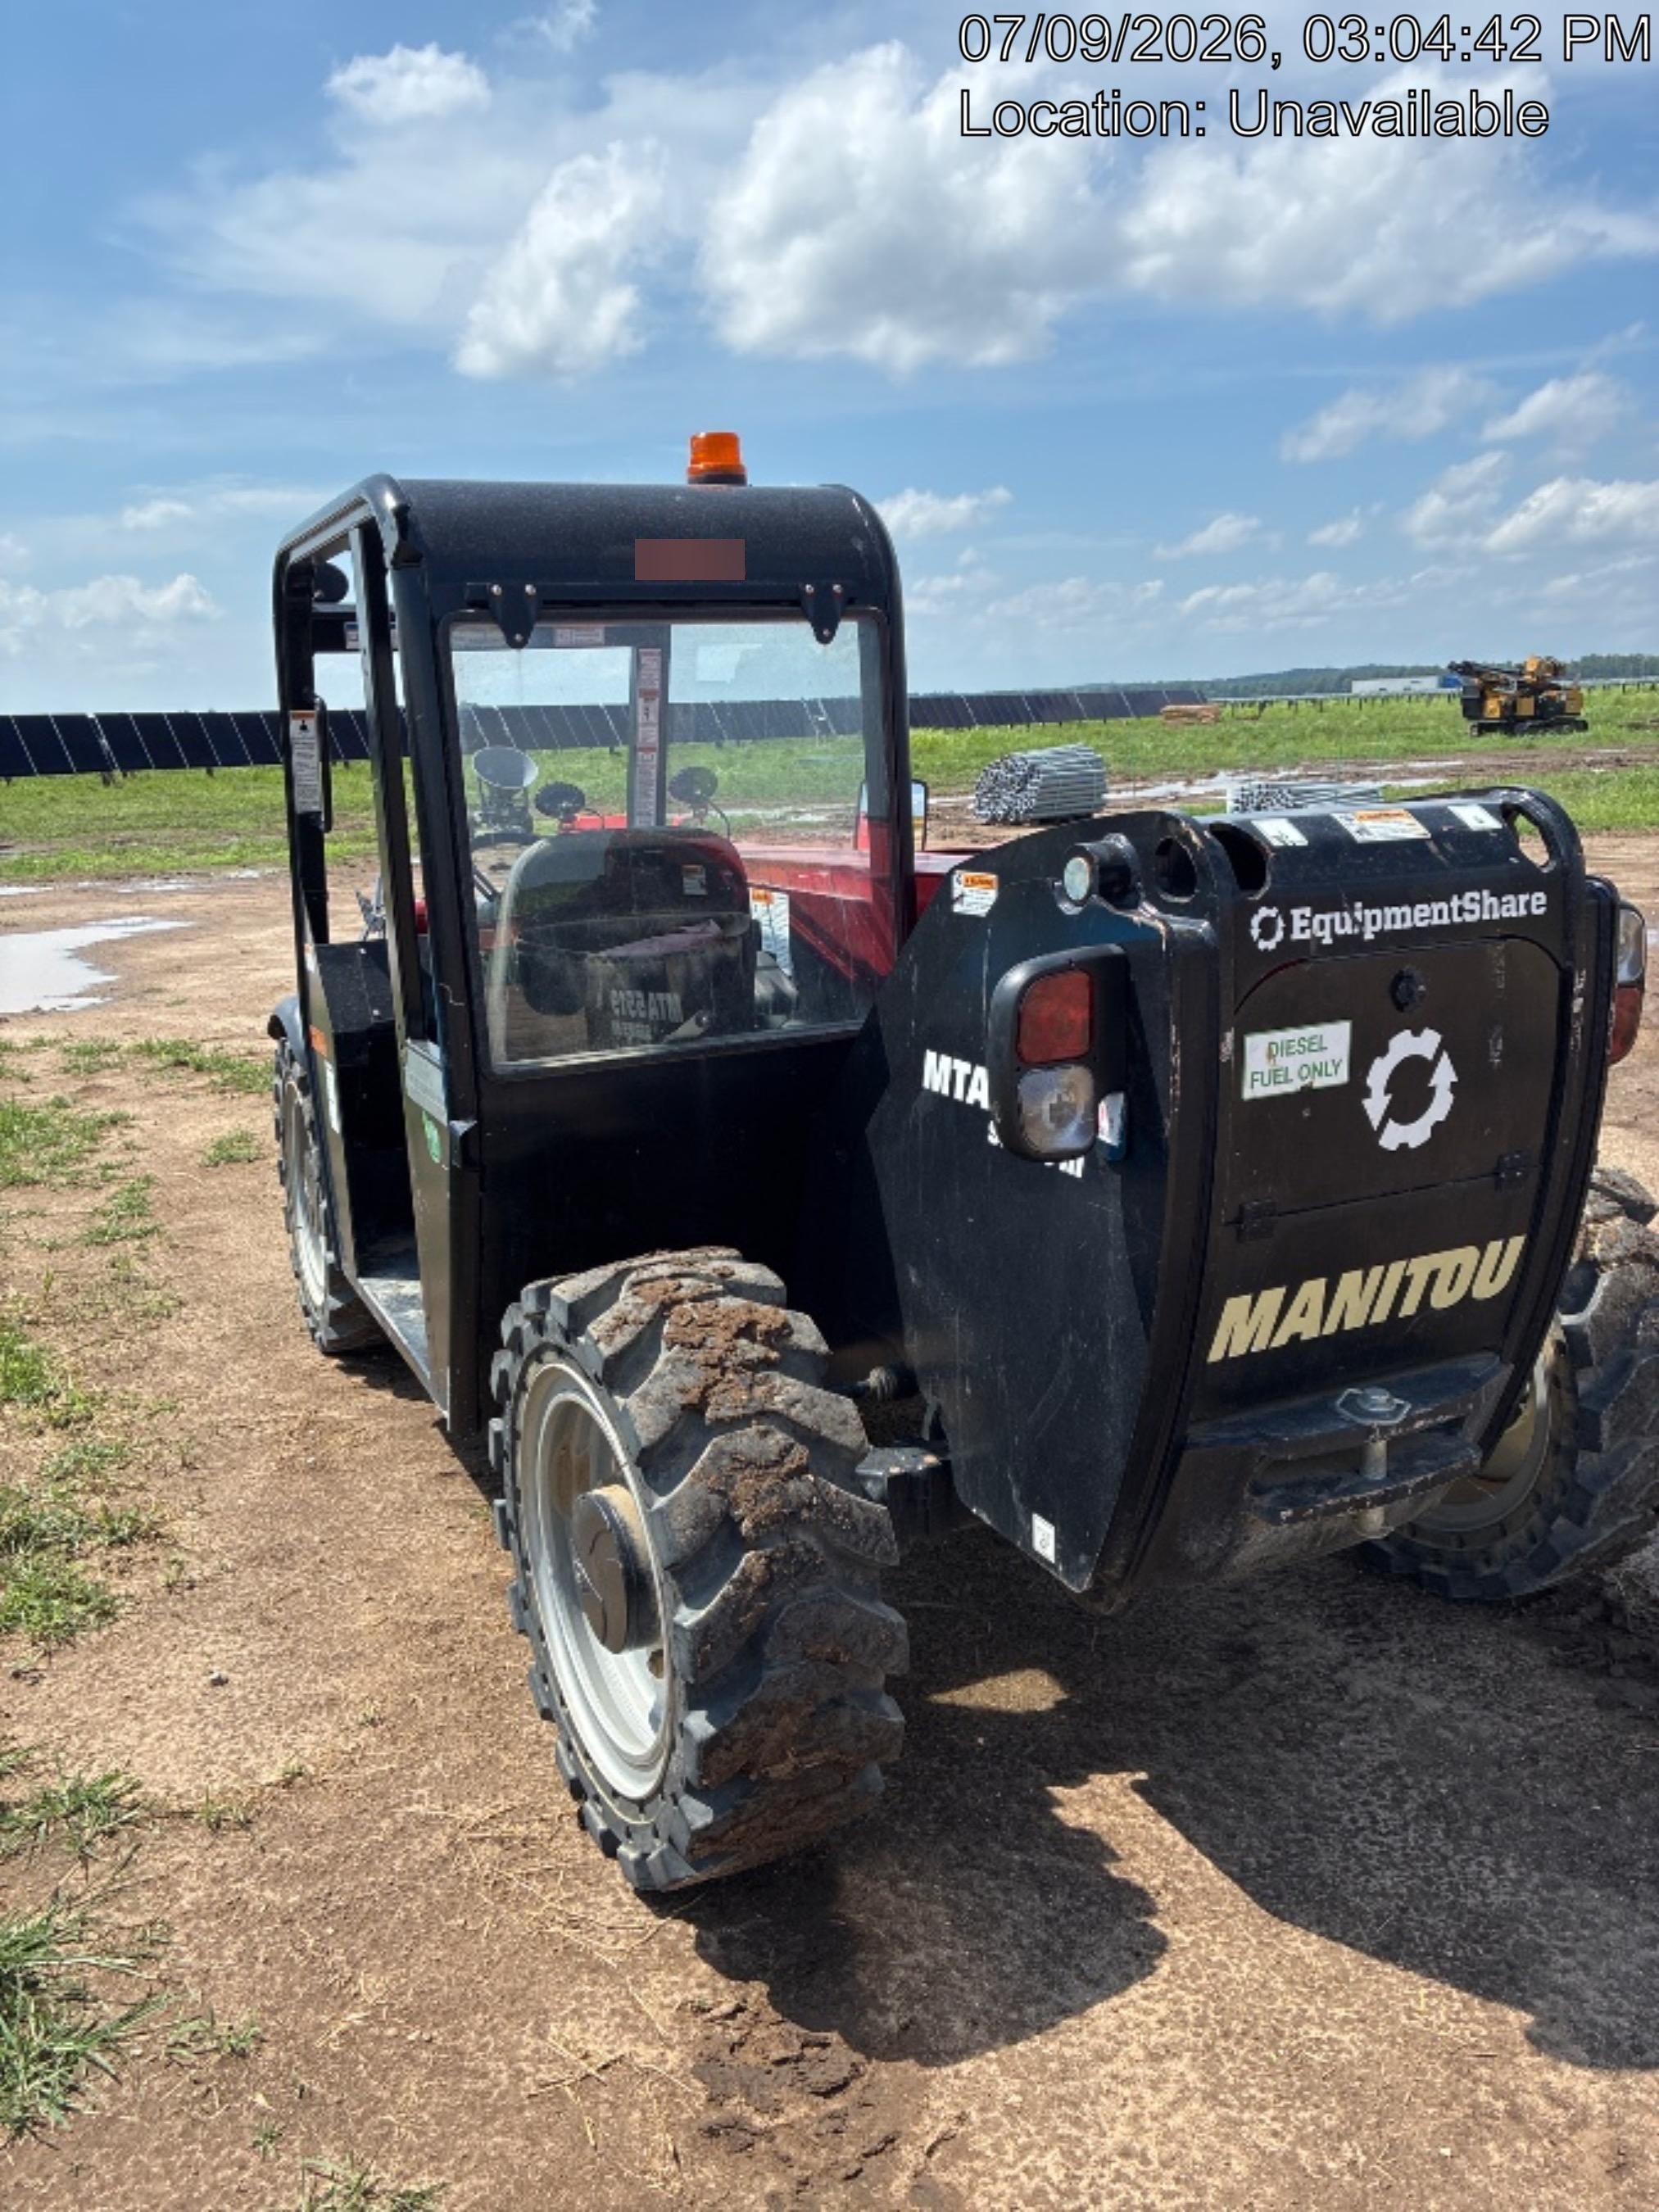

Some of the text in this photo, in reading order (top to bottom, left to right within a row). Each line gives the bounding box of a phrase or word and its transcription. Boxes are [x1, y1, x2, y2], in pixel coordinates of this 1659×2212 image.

[1290, 889, 1548, 945] EquipmentShare
[1267, 1034, 1328, 1058] DIESEL
[1251, 1058, 1344, 1090] FUEL ONLY
[1207, 1234, 1527, 1363] MANITOU
